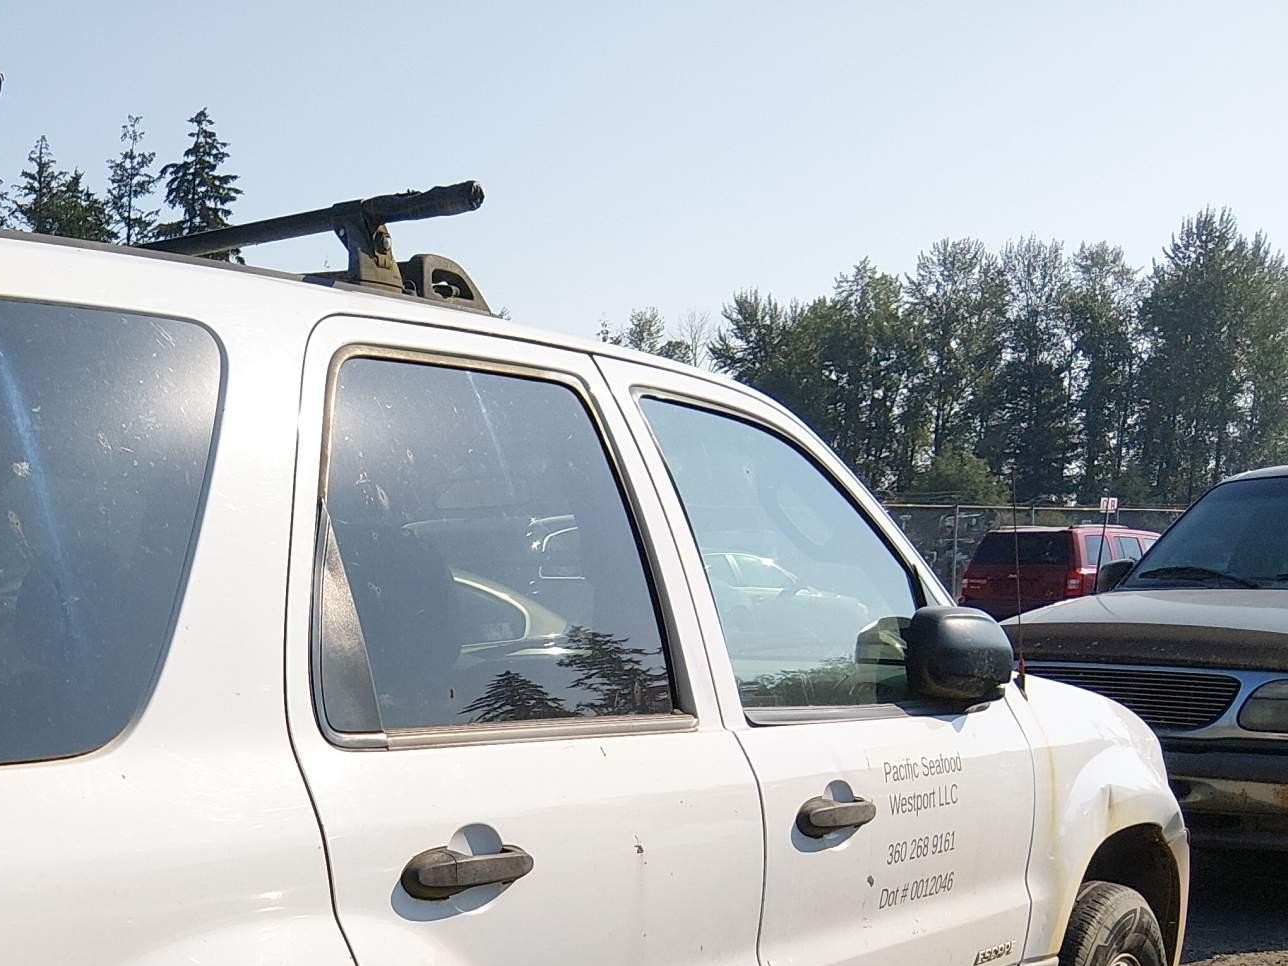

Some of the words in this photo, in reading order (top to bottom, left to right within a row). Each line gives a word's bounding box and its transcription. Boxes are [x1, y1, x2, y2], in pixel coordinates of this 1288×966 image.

[883, 757, 919, 783] Pacific
[920, 751, 962, 776] Seafood
[889, 788, 935, 816] Westport
[938, 783, 958, 806] LLC
[886, 841, 907, 865] 360
[909, 836, 929, 860] 268
[931, 831, 955, 855] 9161
[879, 887, 899, 909] Dot
[900, 882, 910, 904] #
[910, 871, 955, 901] 0012046
